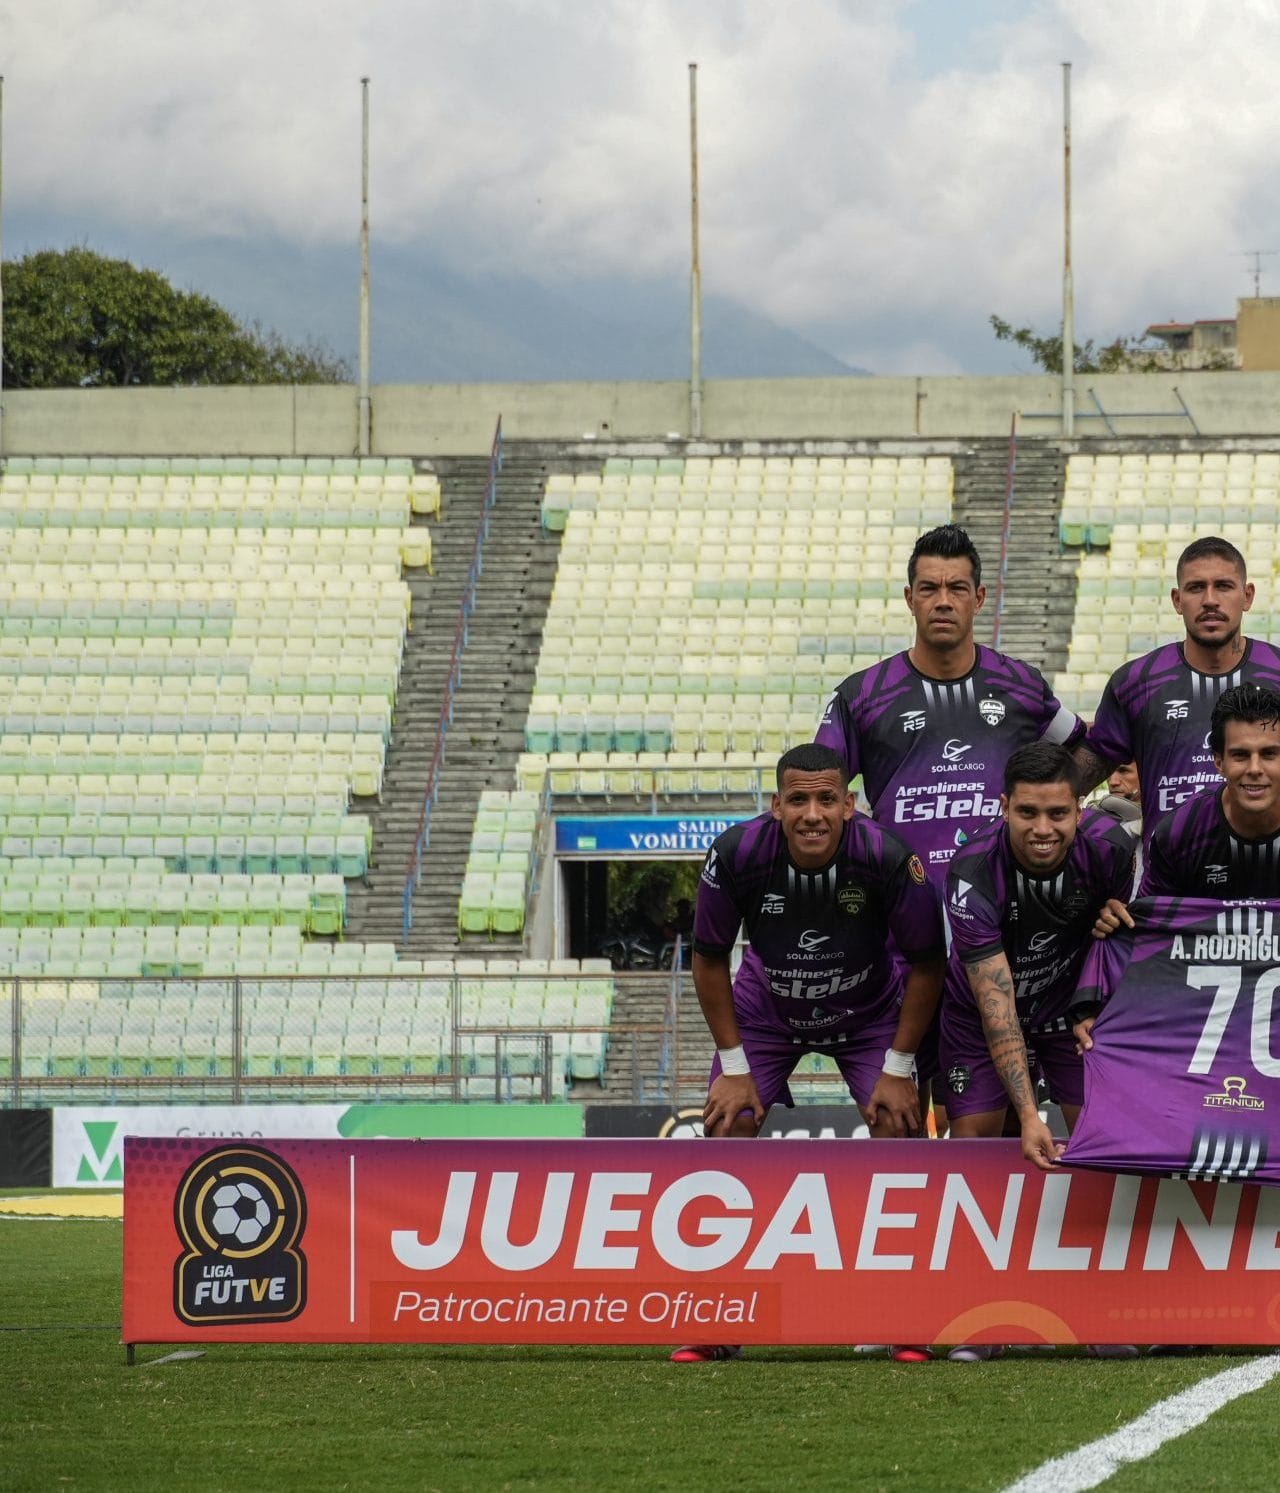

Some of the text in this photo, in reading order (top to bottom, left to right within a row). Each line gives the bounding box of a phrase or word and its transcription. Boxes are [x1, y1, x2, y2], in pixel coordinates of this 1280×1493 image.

[1203, 1096, 1265, 1108] TITANIUM
[202, 1264, 235, 1279] LIGA
[193, 1277, 287, 1306] FUTVE
[393, 1290, 758, 1328] Patrocinante Oficial
